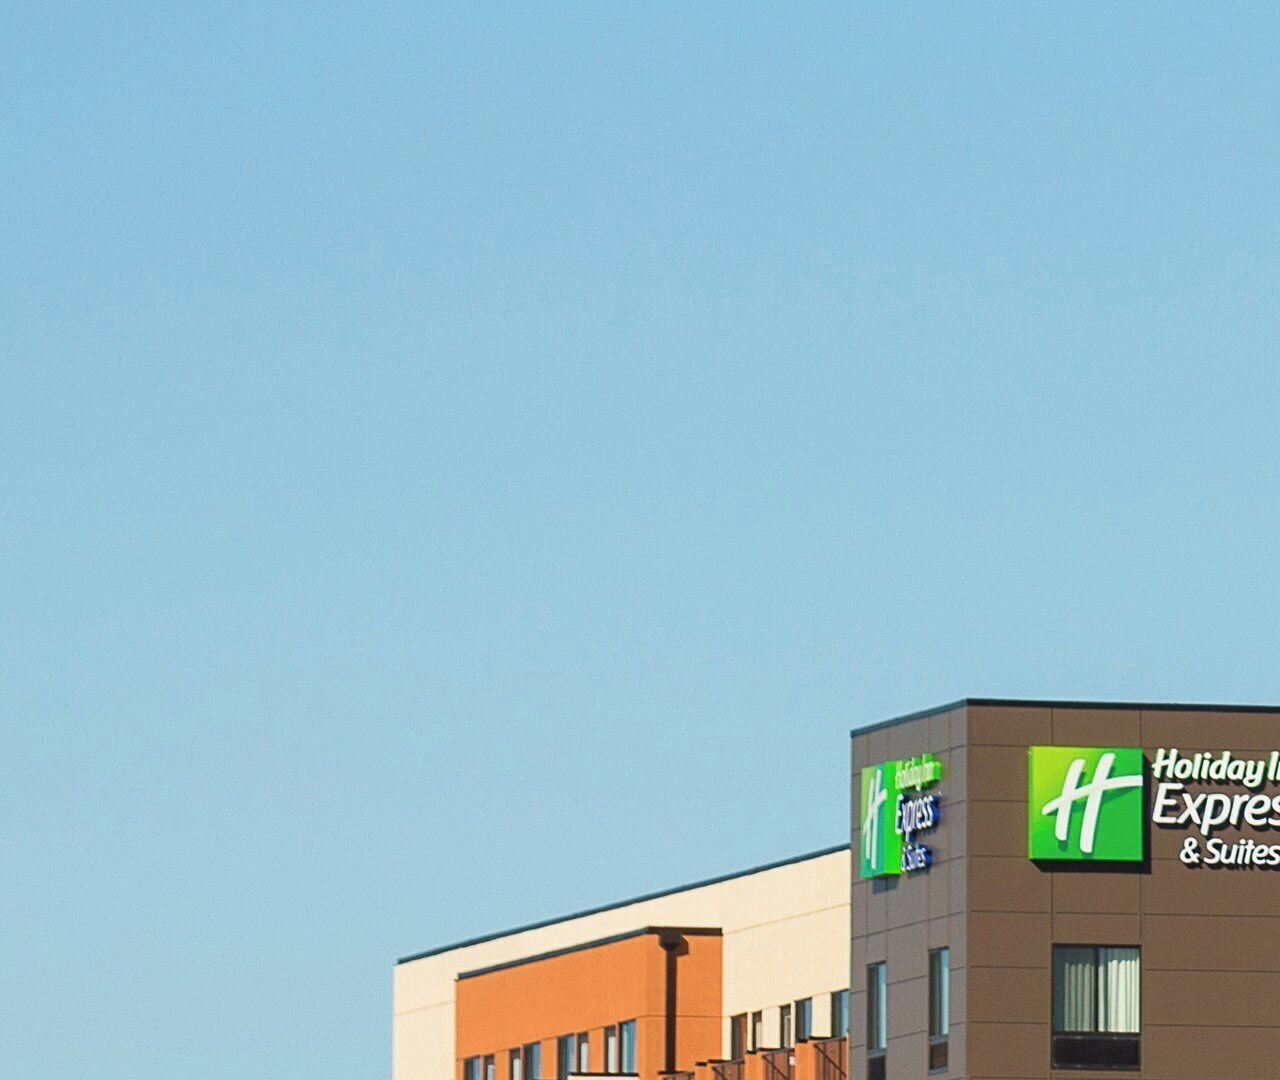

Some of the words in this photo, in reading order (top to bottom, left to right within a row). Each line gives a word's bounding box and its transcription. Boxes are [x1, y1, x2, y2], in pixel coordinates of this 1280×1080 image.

[1151, 748, 1265, 788] Holiday
[895, 794, 934, 842] Express
[1179, 837, 1200, 864] &
